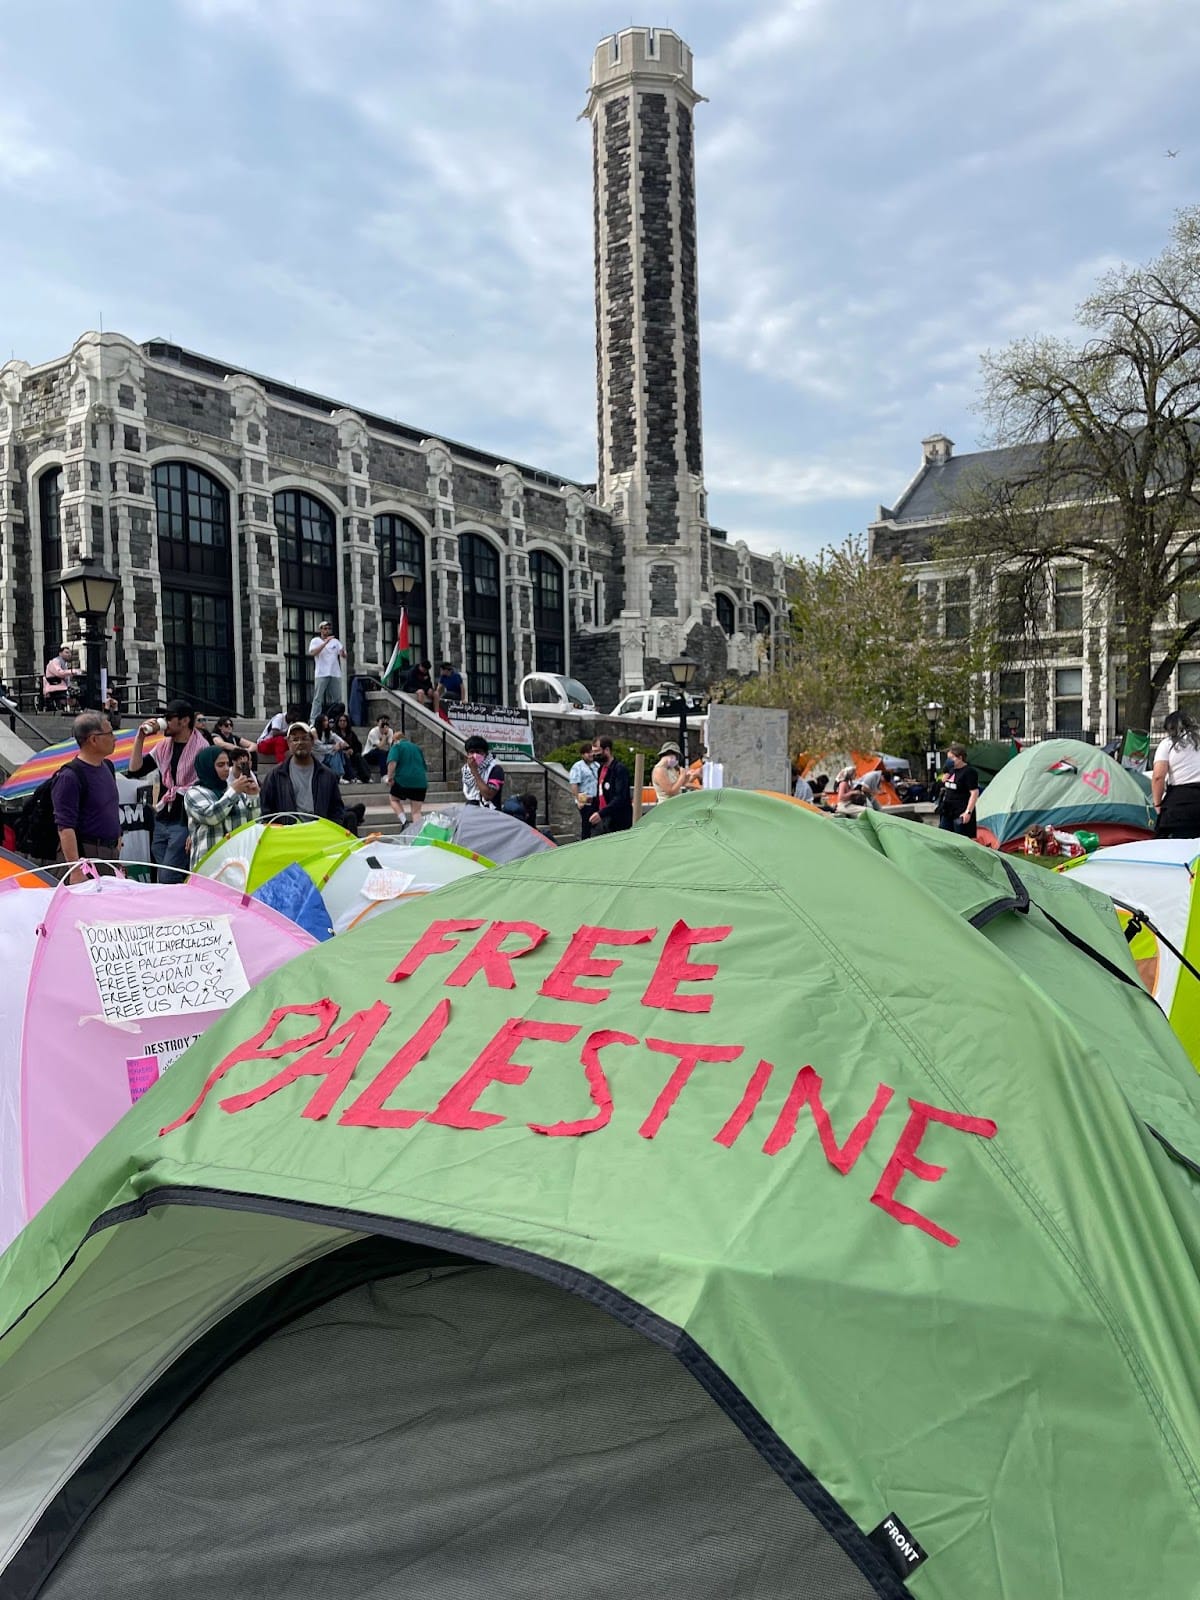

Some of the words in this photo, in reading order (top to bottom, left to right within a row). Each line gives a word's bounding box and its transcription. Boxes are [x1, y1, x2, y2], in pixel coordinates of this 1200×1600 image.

[156, 920, 216, 938] ZIONISM
[95, 961, 137, 978] FREE
[138, 950, 212, 971] PALESTINE
[99, 975, 140, 991] FREE
[141, 964, 193, 985] SUDAN
[386, 919, 733, 1013] FREE
[101, 990, 140, 1004] FREE
[145, 980, 200, 998] CONGO
[104, 1002, 145, 1018] FREE
[147, 999, 172, 1012] US
[180, 992, 216, 1008] ALL
[144, 1036, 191, 1056] DESTROY
[158, 998, 997, 1247] PALESTINE
[883, 1519, 919, 1562] FRONT
